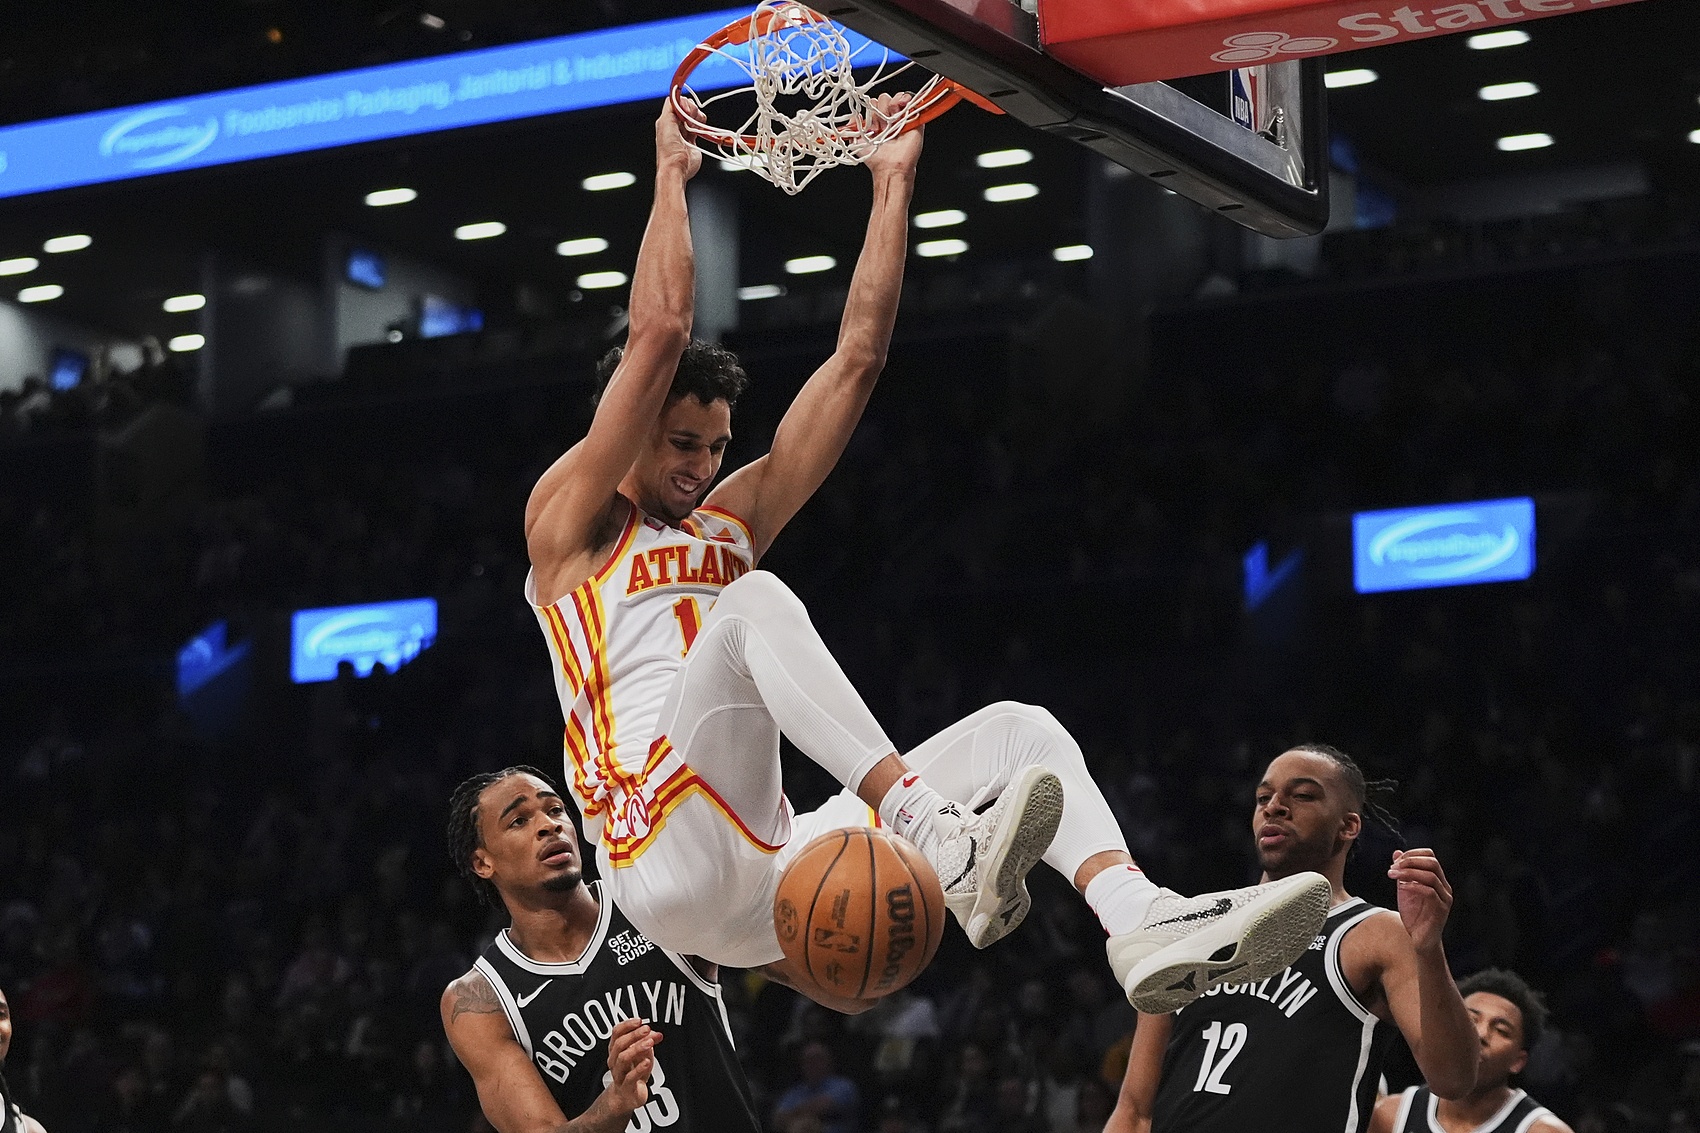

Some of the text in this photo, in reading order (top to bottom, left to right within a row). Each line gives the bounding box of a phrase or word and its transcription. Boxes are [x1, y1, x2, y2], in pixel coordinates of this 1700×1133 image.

[226, 99, 343, 137] Foodservice
[576, 46, 674, 83] Industrial
[1234, 94, 1250, 124] NBA
[626, 543, 751, 597] ATLANT
[608, 929, 630, 948] GET
[611, 933, 648, 956] YOUR
[617, 940, 655, 966] GUIDE
[535, 980, 686, 1084] BROOKLYN
[1193, 1021, 1248, 1095] 12
[602, 1047, 681, 1133] 3
